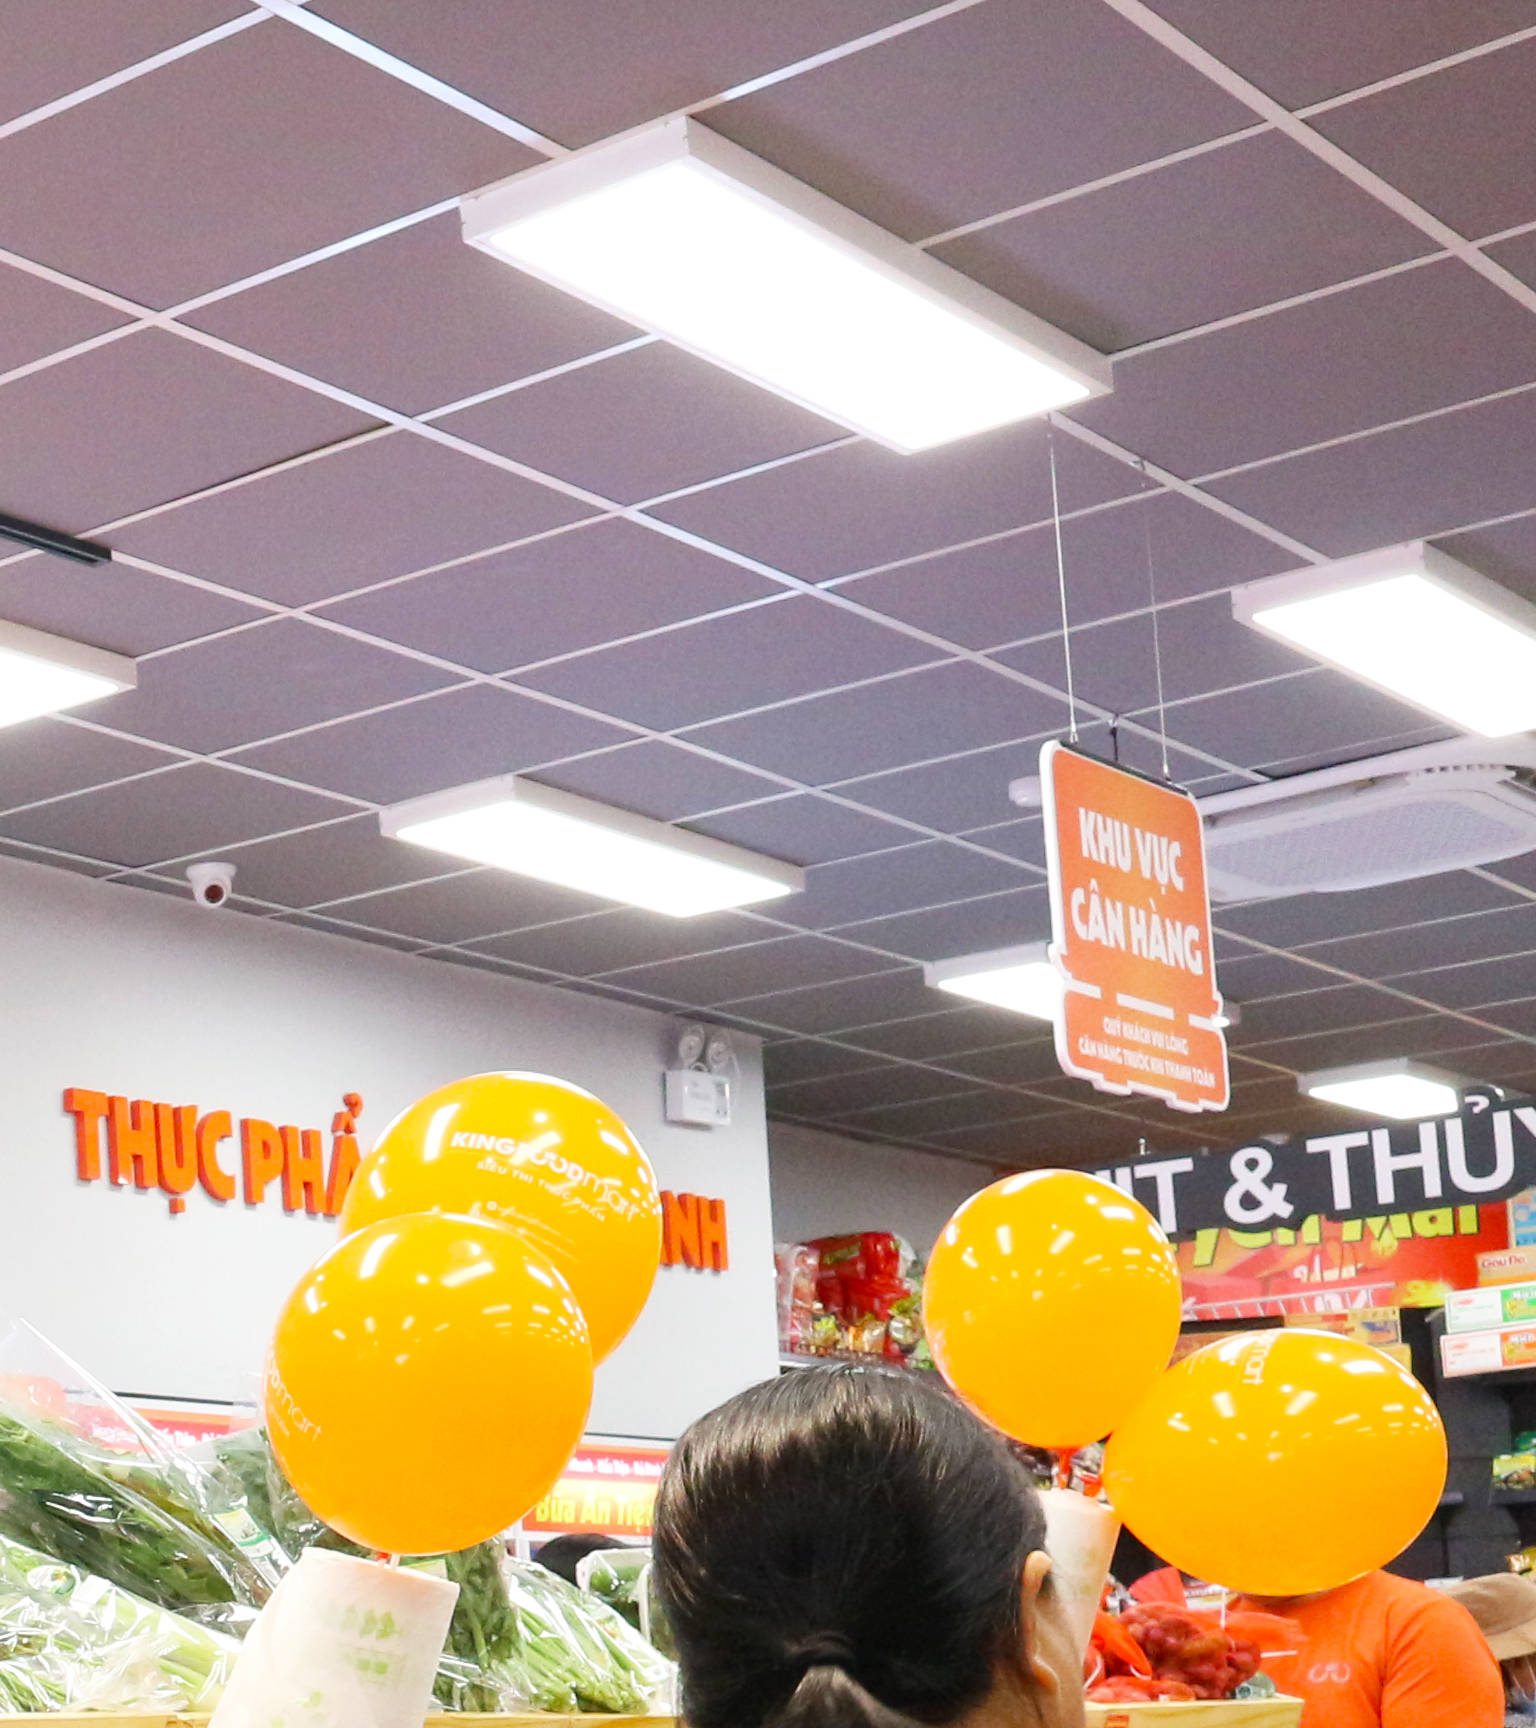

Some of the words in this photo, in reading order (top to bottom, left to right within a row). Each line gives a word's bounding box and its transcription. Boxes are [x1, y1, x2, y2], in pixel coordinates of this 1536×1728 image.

[1079, 807, 1131, 872] KHU
[1135, 828, 1184, 895] VỰC
[1071, 878, 1126, 952] CÂN
[1131, 898, 1203, 975] HÀNG
[64, 1088, 235, 1213] THỰC
[240, 1092, 364, 1217] PHẨ
[1224, 1146, 1294, 1225] &
